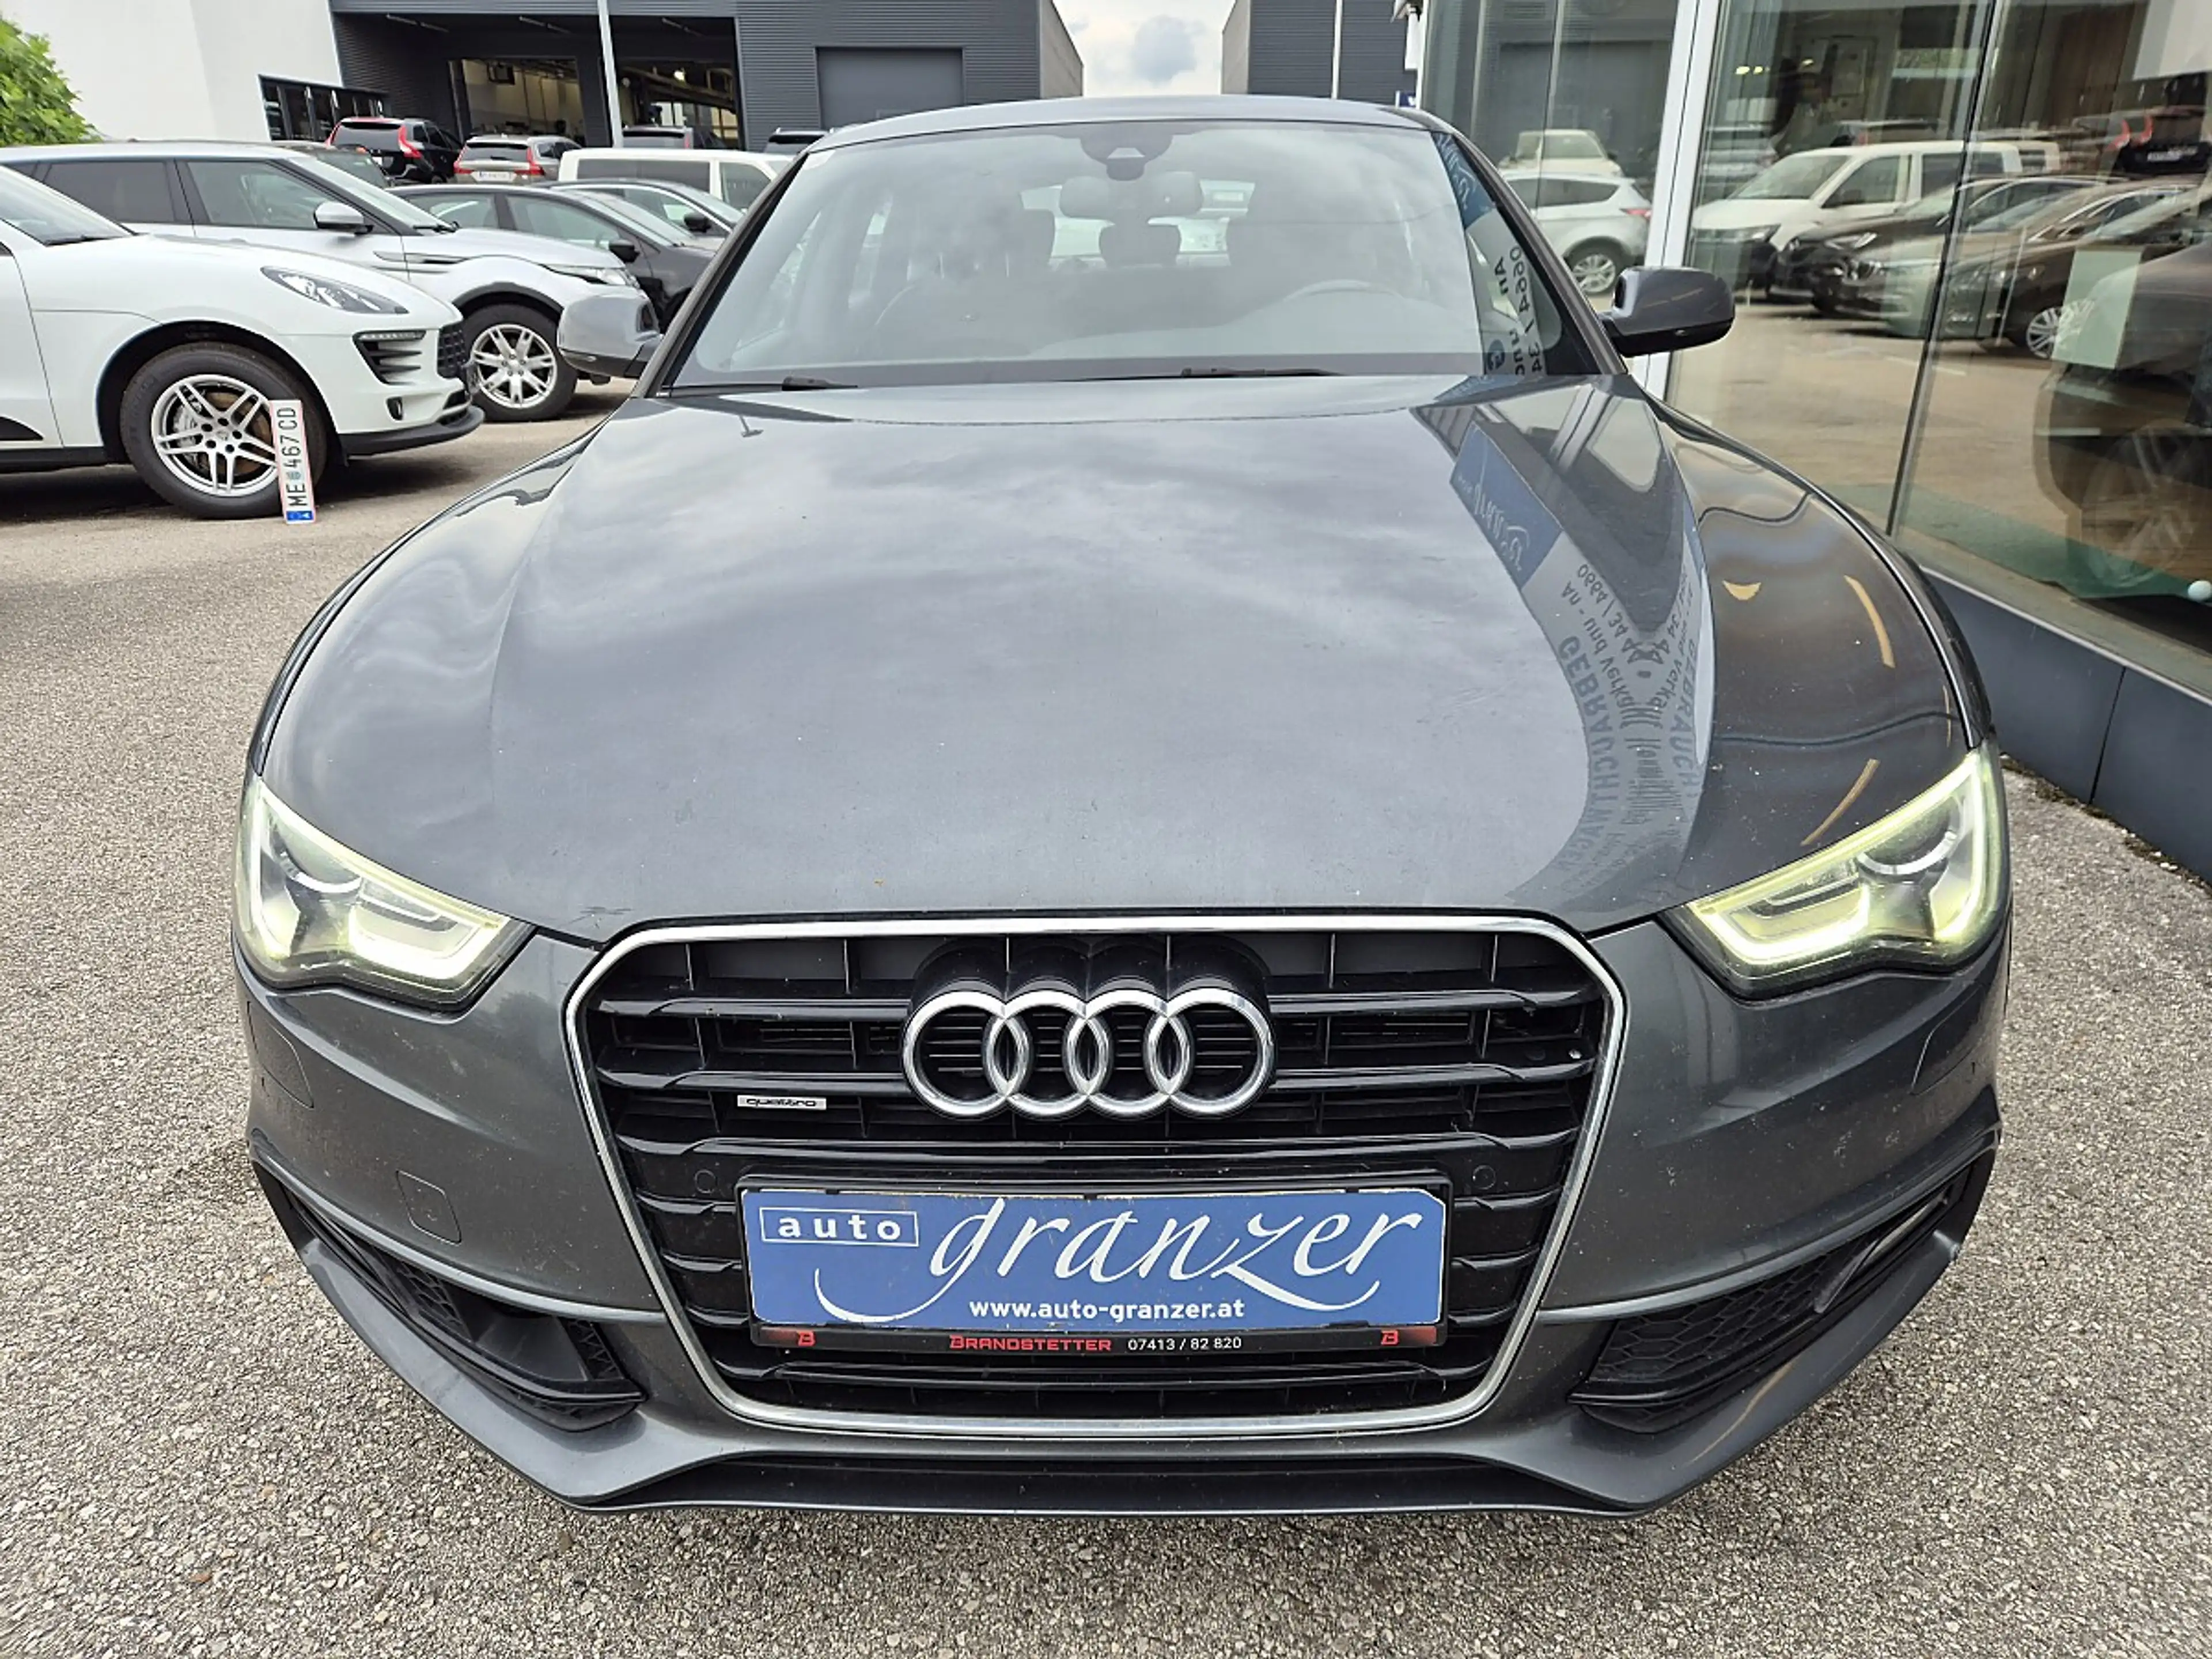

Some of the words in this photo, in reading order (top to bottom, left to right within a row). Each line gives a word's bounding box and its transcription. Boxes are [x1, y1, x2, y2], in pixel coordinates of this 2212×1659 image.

[286, 483, 308, 506] ME
[746, 1098, 816, 1107] quattro
[778, 1214, 901, 1241] auto
[814, 1198, 1423, 1323] granzer
[969, 1298, 1245, 1323] www.auto-granzer.at
[949, 1334, 1112, 1352] BRANDSTETTER
[1127, 1338, 1176, 1351] 07413
[1190, 1337, 1209, 1351] 82
[1213, 1336, 1243, 1350] 820
